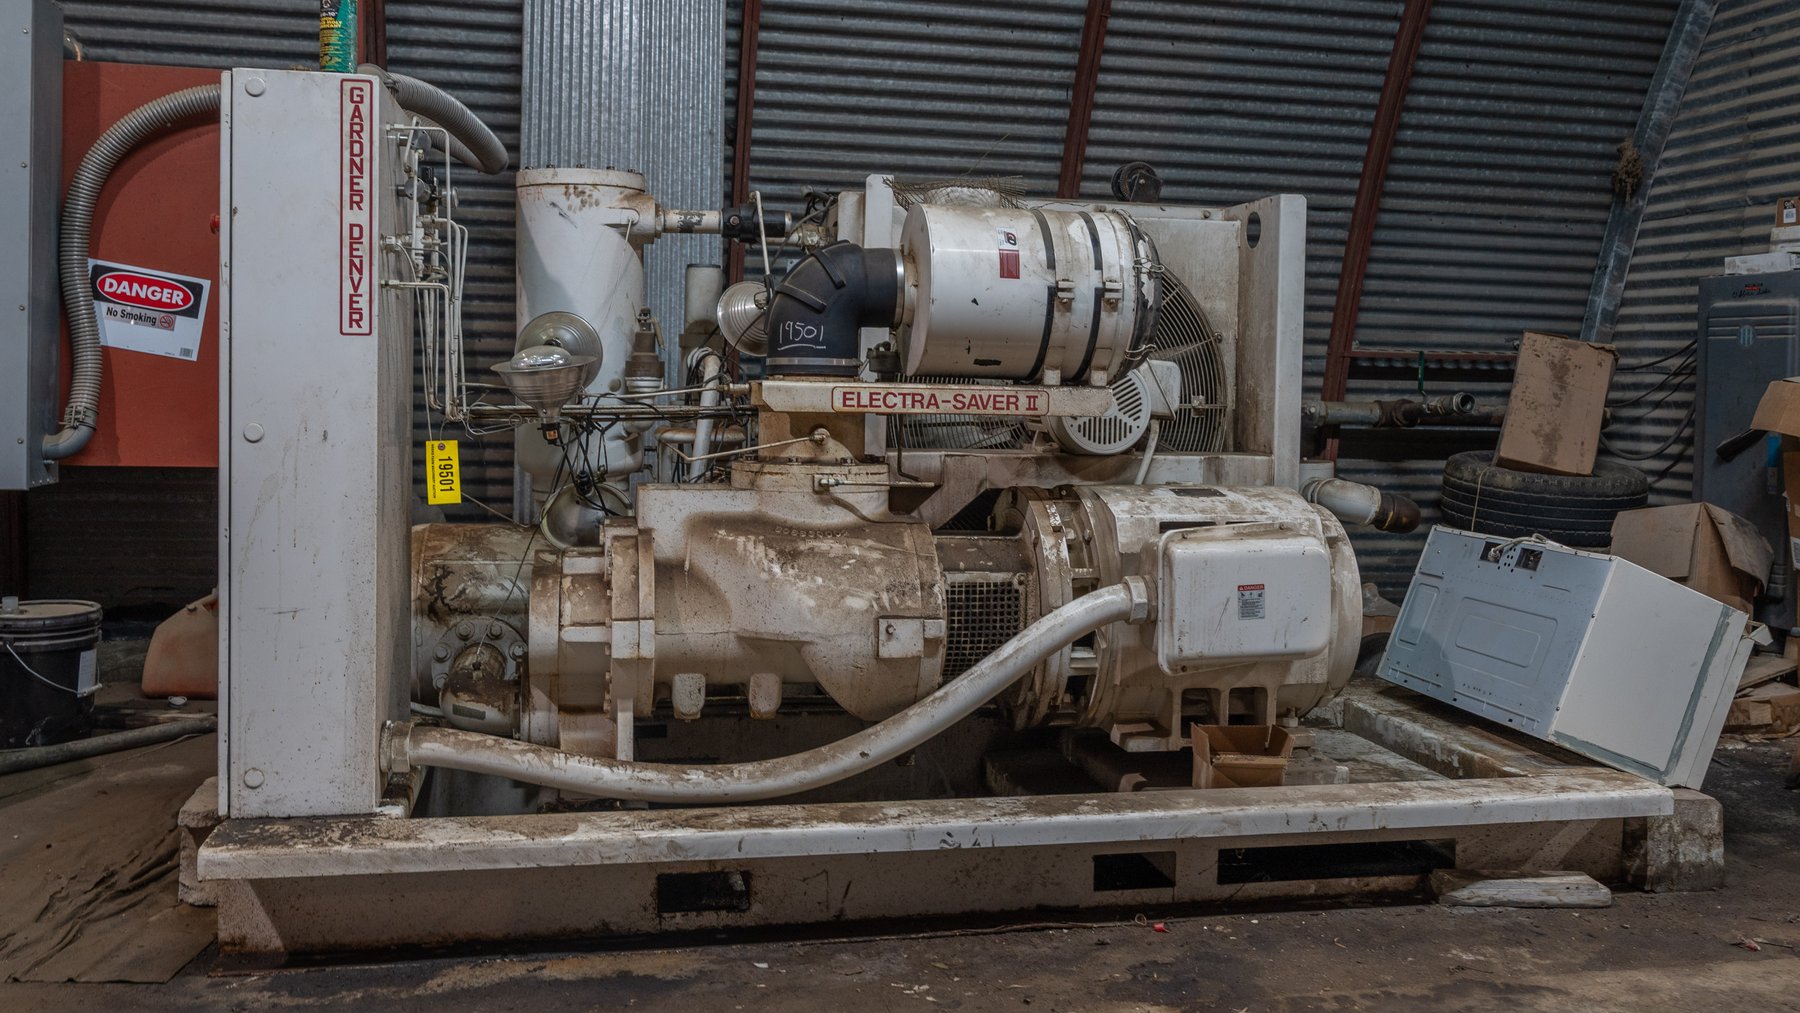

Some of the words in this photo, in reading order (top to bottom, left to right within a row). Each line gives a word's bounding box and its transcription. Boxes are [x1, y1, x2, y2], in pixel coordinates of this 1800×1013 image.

[349, 87, 364, 211] GARDNER
[348, 223, 364, 329] DENVER
[103, 277, 184, 305] DANGER
[106, 307, 118, 317] No
[120, 310, 157, 326] Smoking
[779, 320, 824, 345] 19501
[842, 391, 1020, 411] ELECTRA-SAVER
[1025, 395, 1039, 411] II
[438, 456, 455, 492] 19501
